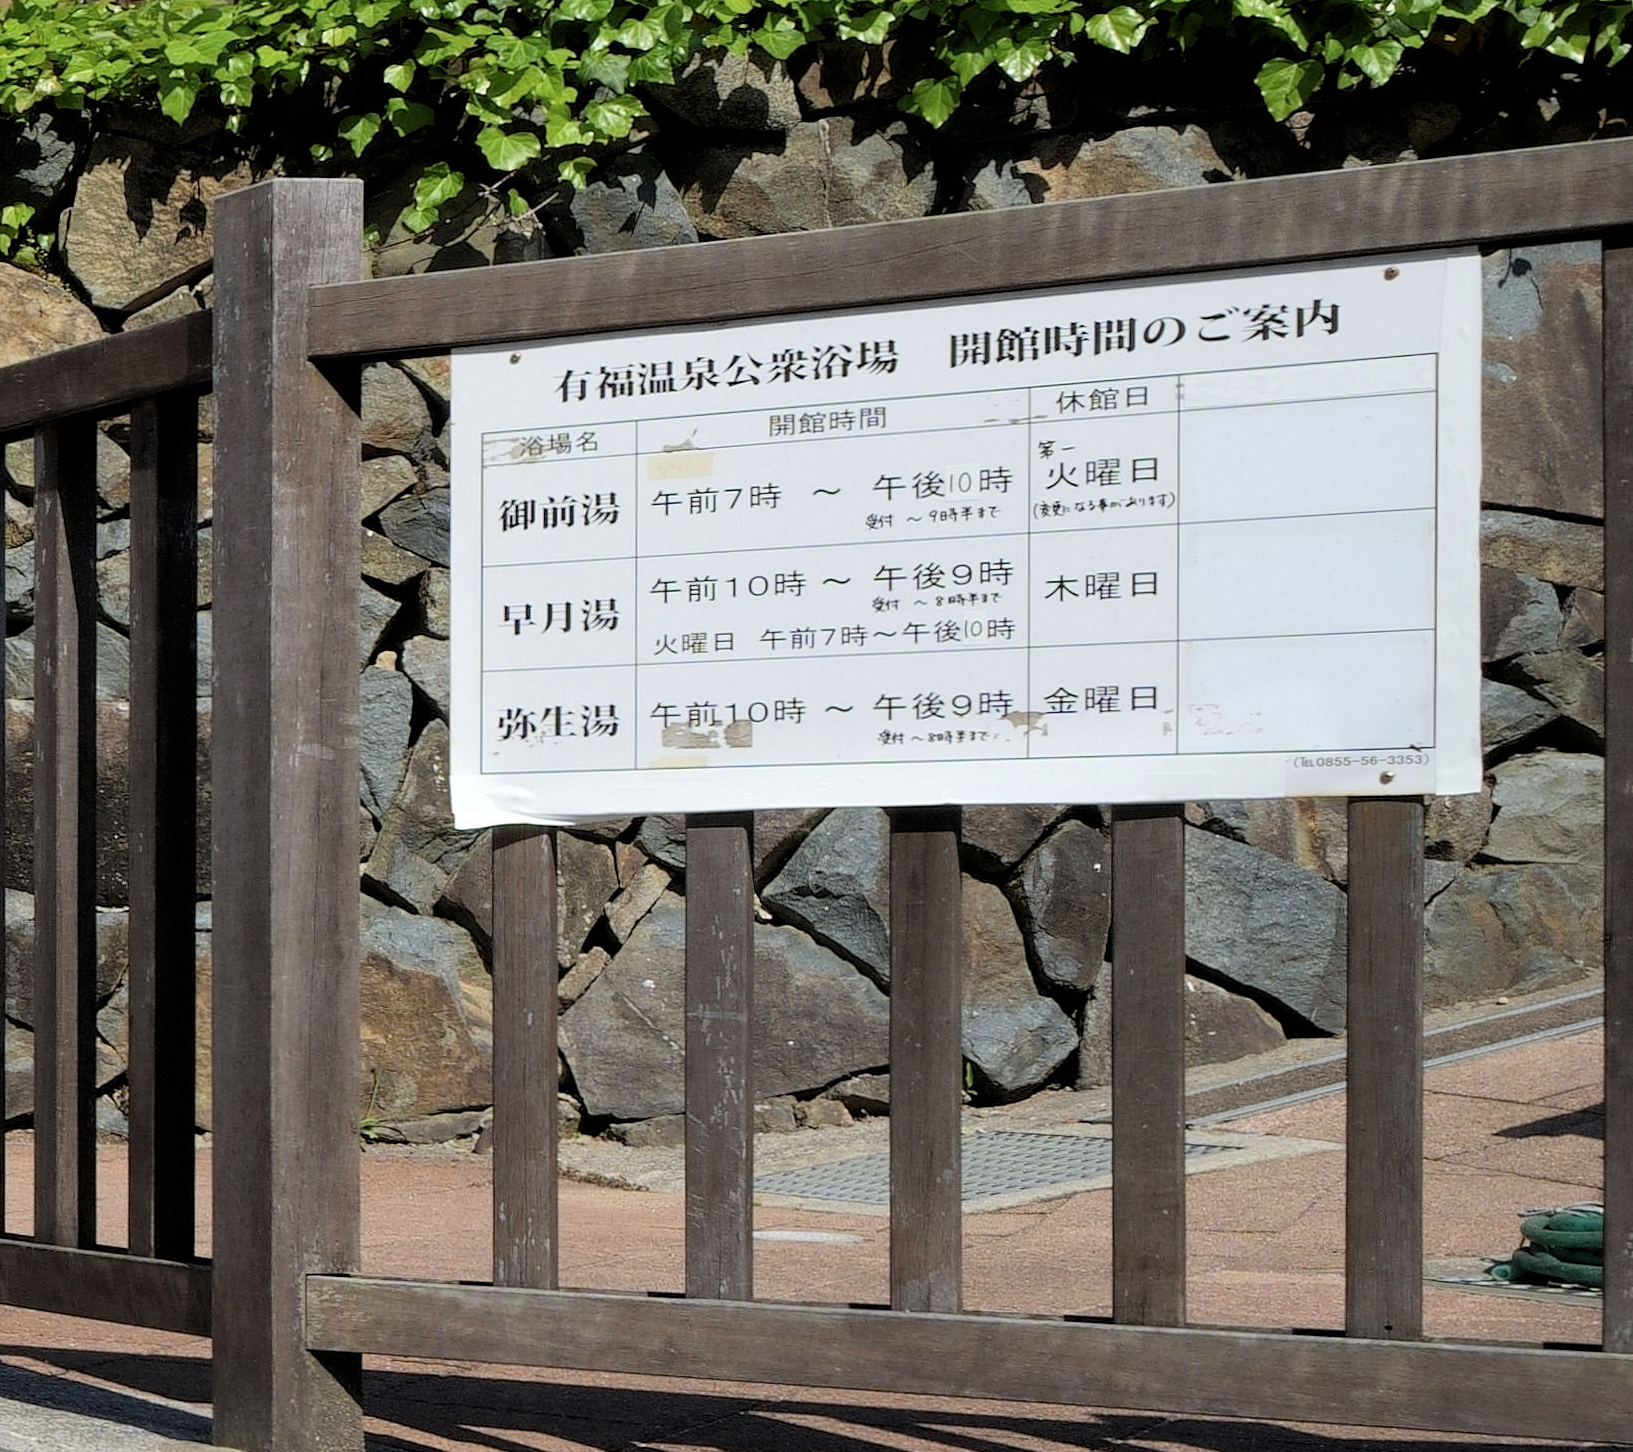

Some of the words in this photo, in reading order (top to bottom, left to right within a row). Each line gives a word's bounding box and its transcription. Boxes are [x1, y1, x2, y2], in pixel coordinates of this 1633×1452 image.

[554, 339, 899, 403] 有福温泉公衆浴場
[949, 299, 1340, 367] 開館時間のご案内
[520, 432, 599, 455] 浴場名
[769, 406, 887, 437] 開館時間
[1056, 386, 1149, 413] 休館日
[1038, 440, 1076, 459] 第一
[498, 491, 619, 532] 御前湯
[1046, 457, 1157, 490] 火曜日
[498, 597, 619, 637] 早月湯
[1044, 571, 1158, 603] 木曜日
[654, 630, 735, 656] 火曜日
[497, 703, 619, 741] 弥生湯
[1044, 684, 1158, 715] 金曜日
